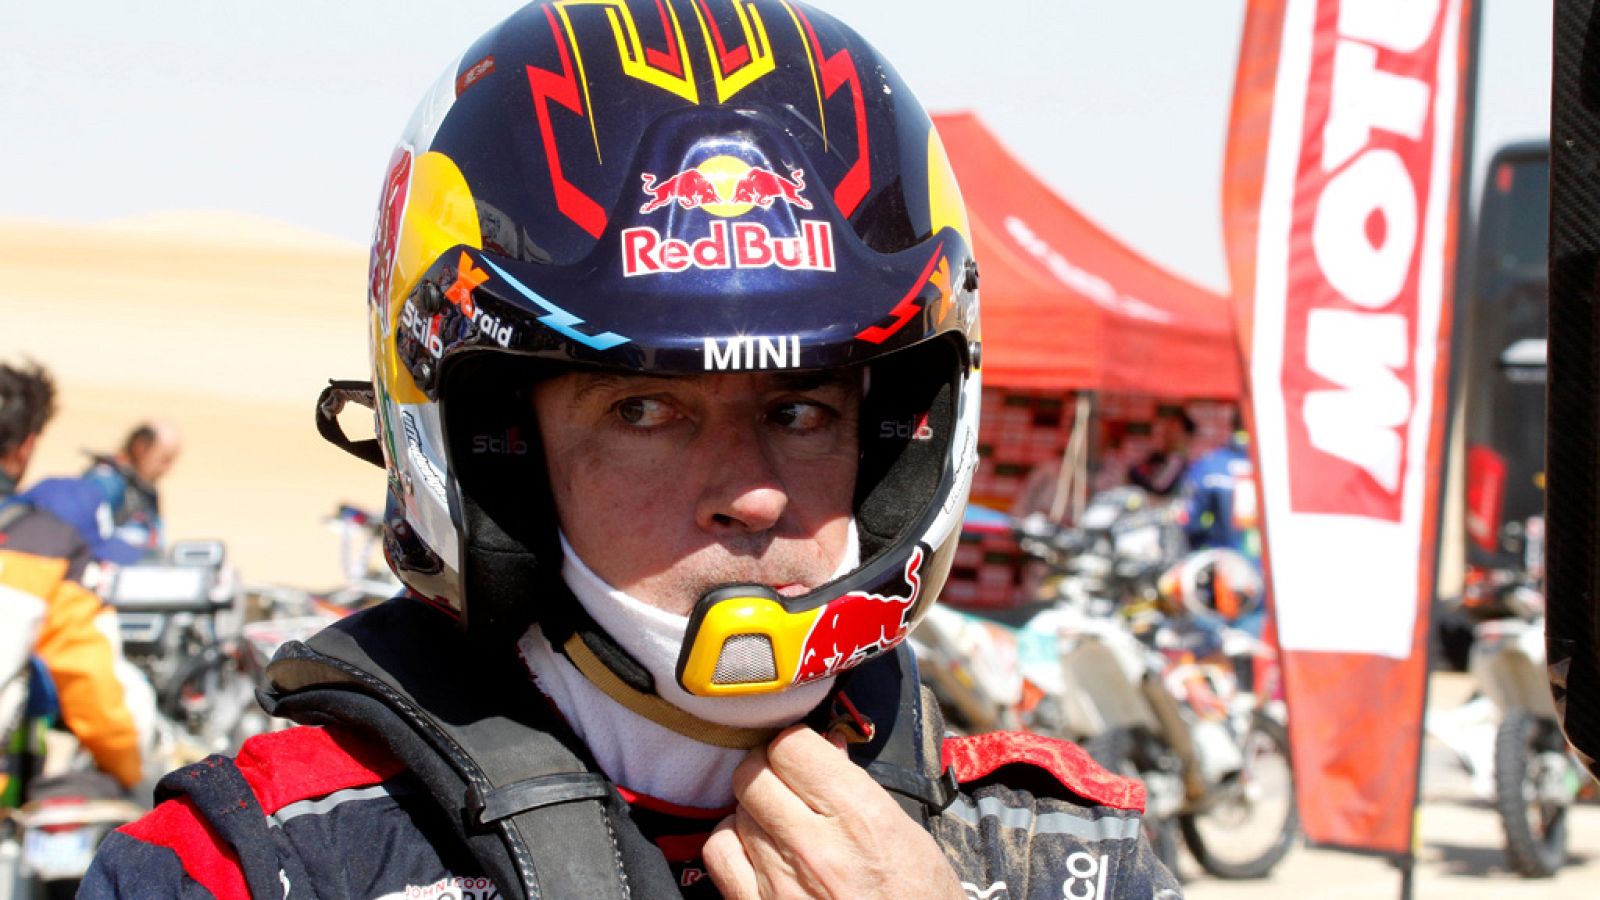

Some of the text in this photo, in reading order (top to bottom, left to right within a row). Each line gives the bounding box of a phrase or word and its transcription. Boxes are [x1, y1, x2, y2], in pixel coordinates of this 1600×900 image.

[622, 220, 836, 277] Red Bull
[704, 335, 801, 371] MINI
